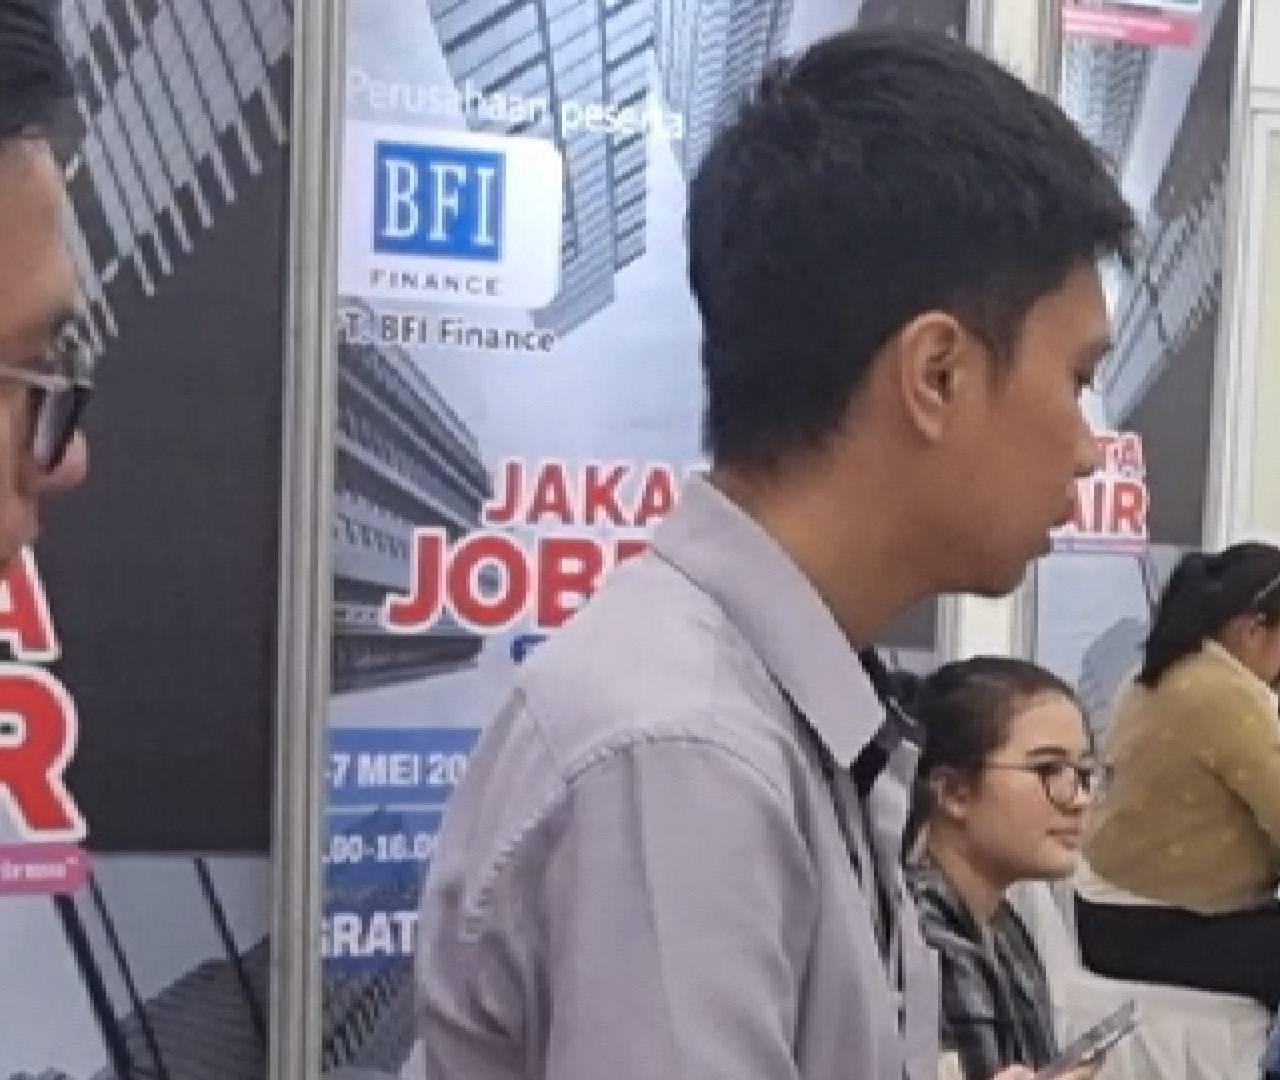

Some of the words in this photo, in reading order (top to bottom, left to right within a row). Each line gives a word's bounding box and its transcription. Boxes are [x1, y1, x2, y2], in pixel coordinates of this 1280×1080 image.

[381, 159, 497, 248] BFI
[369, 269, 500, 297] FINANCE
[380, 313, 427, 344] BFI
[440, 318, 556, 352] Finance
[483, 460, 675, 526] JAKA
[386, 533, 652, 628] JOB
[356, 752, 420, 786] MEI
[425, 752, 468, 786] 20
